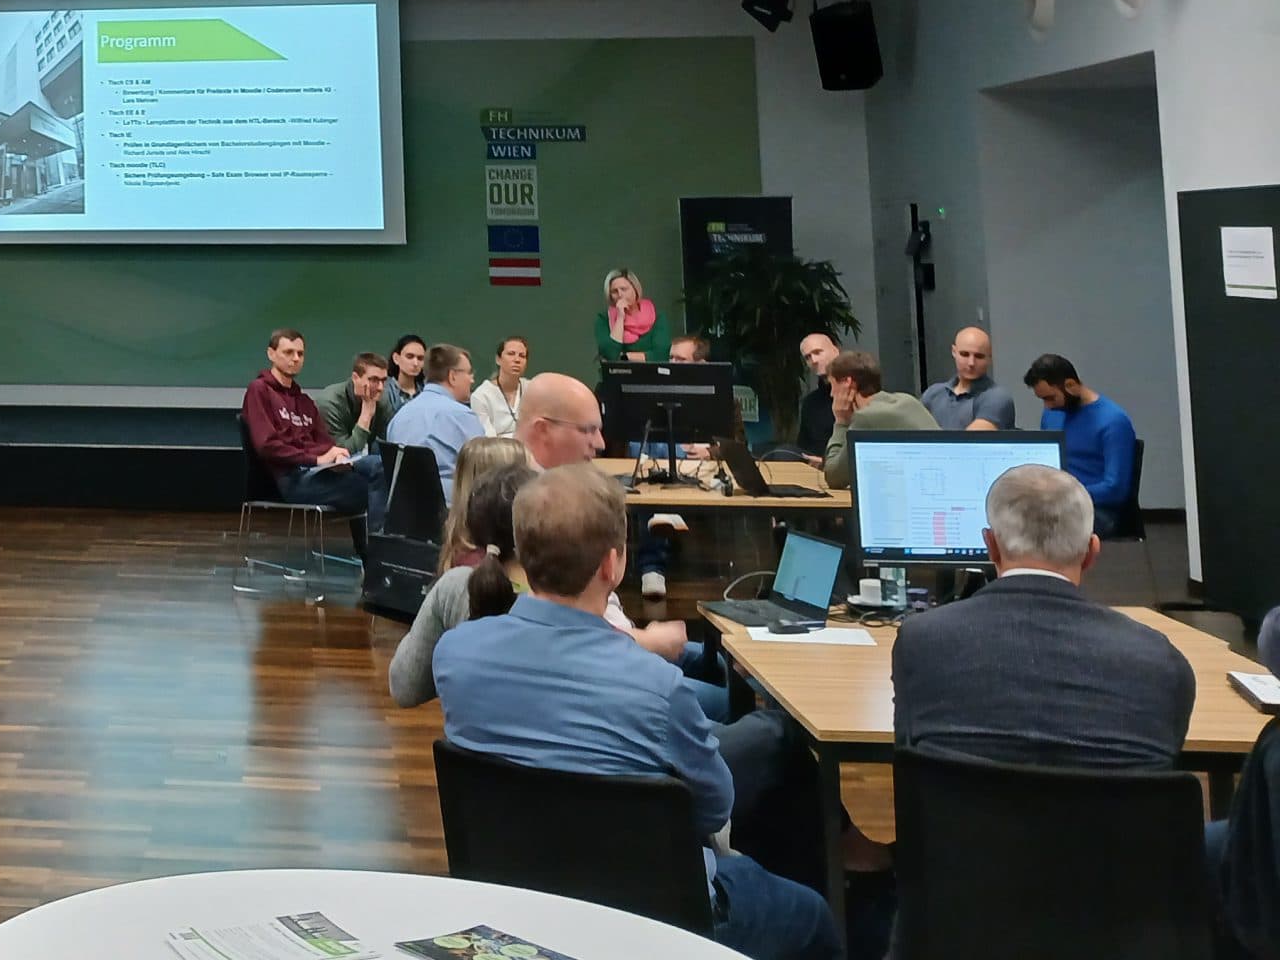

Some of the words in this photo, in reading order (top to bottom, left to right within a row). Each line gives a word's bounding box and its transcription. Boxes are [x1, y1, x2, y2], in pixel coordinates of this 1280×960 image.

[100, 35, 176, 50] Programm
[488, 110, 508, 122] FH
[490, 128, 582, 140] TECHNIKUM
[492, 146, 532, 157] WIEN
[488, 168, 534, 181] CHANGE
[490, 183, 534, 205] OUR
